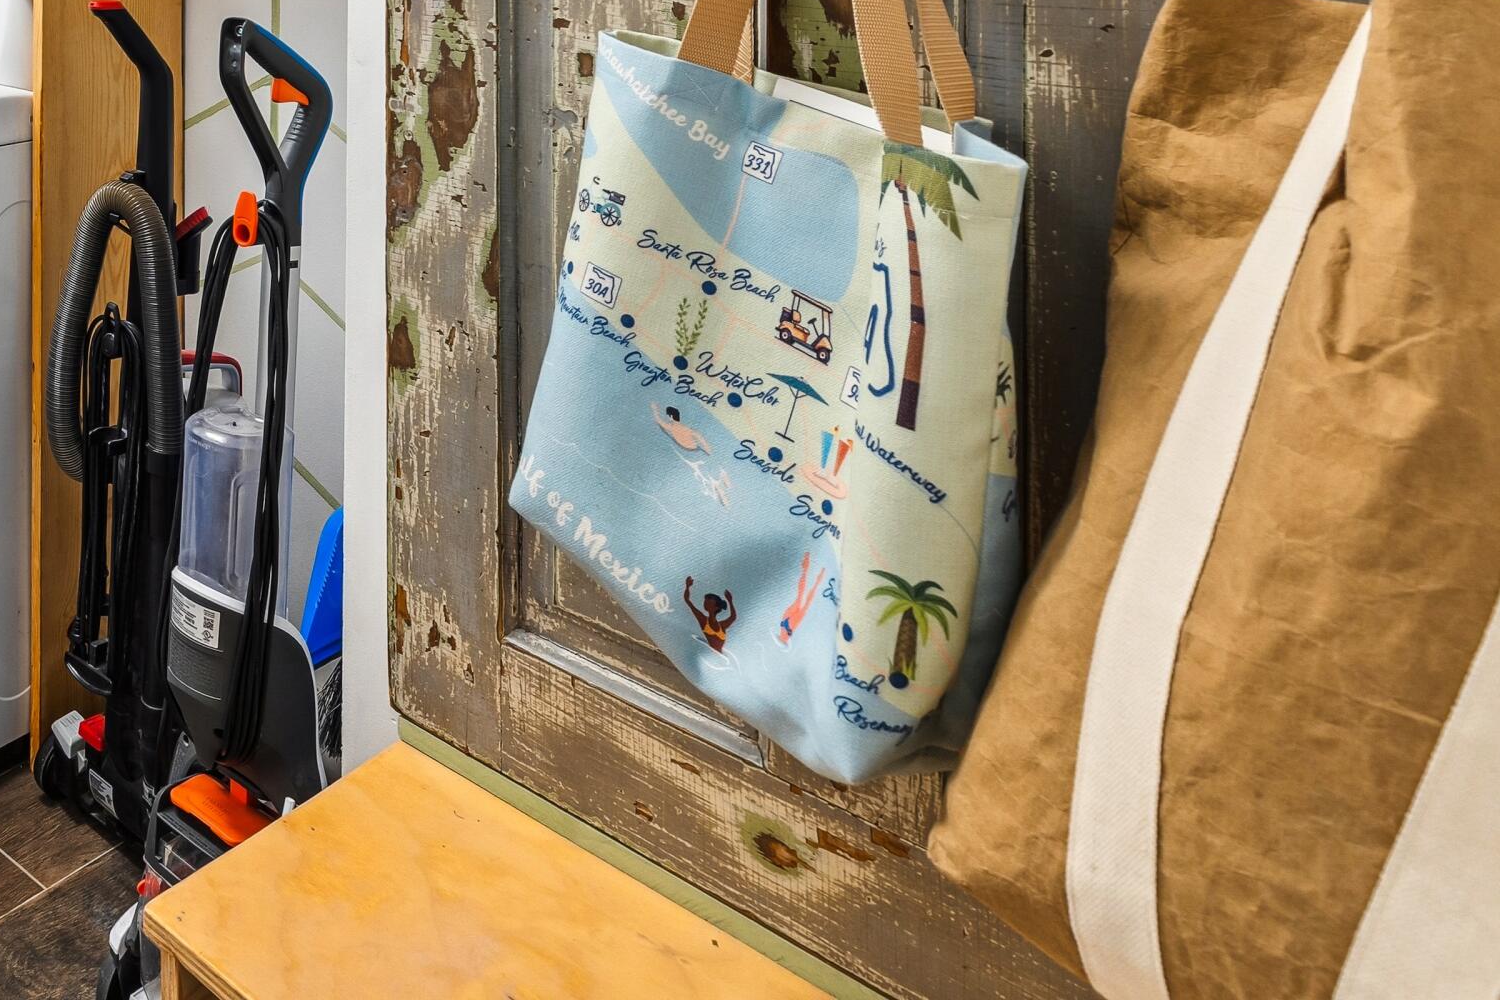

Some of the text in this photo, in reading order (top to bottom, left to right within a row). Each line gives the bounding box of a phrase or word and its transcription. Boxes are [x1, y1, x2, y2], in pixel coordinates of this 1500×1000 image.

[688, 118, 731, 161] Bay
[744, 153, 772, 175] 331
[584, 277, 610, 299] 30A
[637, 229, 781, 303] Santa Rosa Beach
[589, 314, 637, 348] Beach
[623, 350, 725, 407] Grayton Beach
[695, 351, 780, 406] WaterColor
[733, 438, 797, 484] Seaside
[865, 431, 947, 504] Waterway
[546, 490, 574, 527] of
[573, 515, 675, 615] Mexico
[834, 653, 886, 696] Beach
